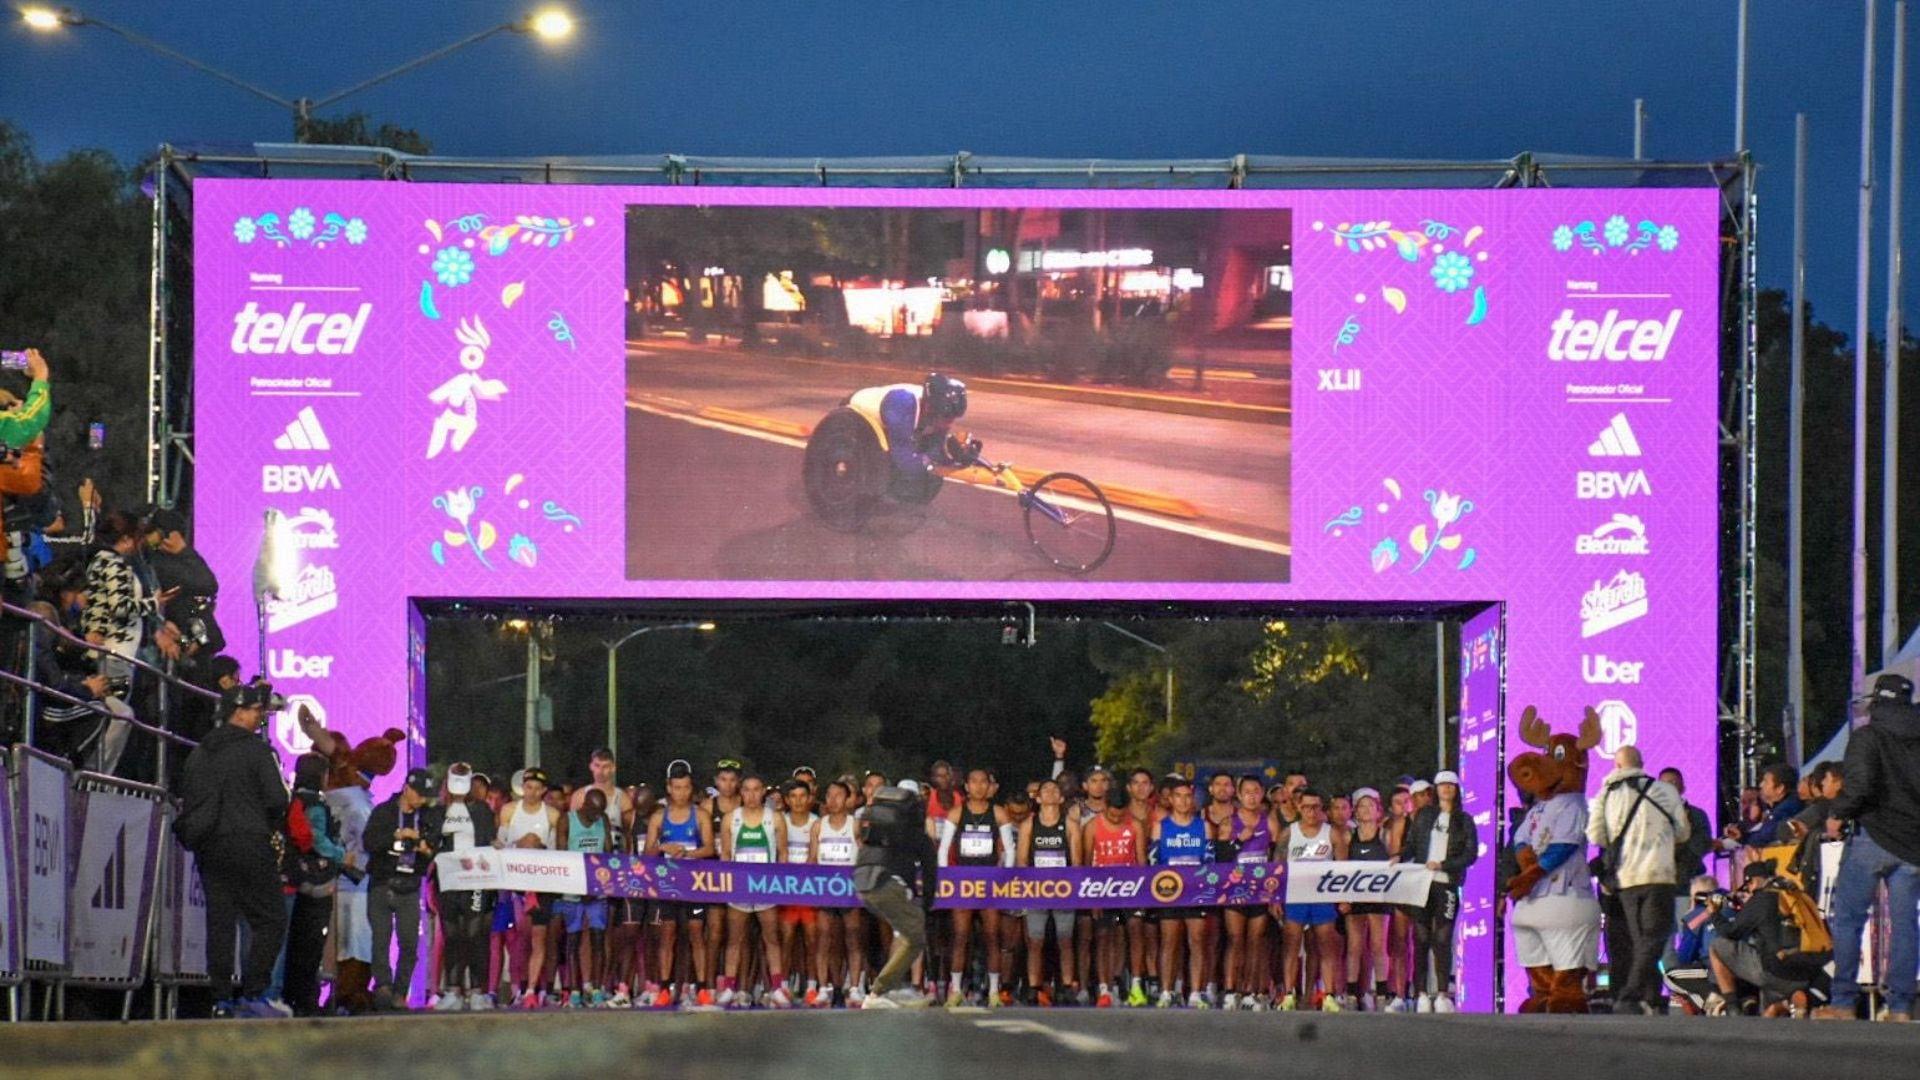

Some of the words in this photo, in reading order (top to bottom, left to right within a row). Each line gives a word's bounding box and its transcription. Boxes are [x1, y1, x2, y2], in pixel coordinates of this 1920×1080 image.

[231, 301, 373, 355] telcel
[1547, 308, 1683, 362] telcel
[1317, 368, 1361, 391] XLII
[262, 463, 341, 493] BBVA
[1576, 469, 1652, 500] BBVA
[268, 648, 334, 679] Uber
[1581, 654, 1644, 684] Uber
[506, 863, 571, 877] INDEPORTE
[691, 871, 733, 893] XLII
[1316, 869, 1400, 893] telcel
[960, 880, 987, 898] DE
[992, 876, 1073, 899] MÉXICO
[1078, 876, 1145, 898] telcel
